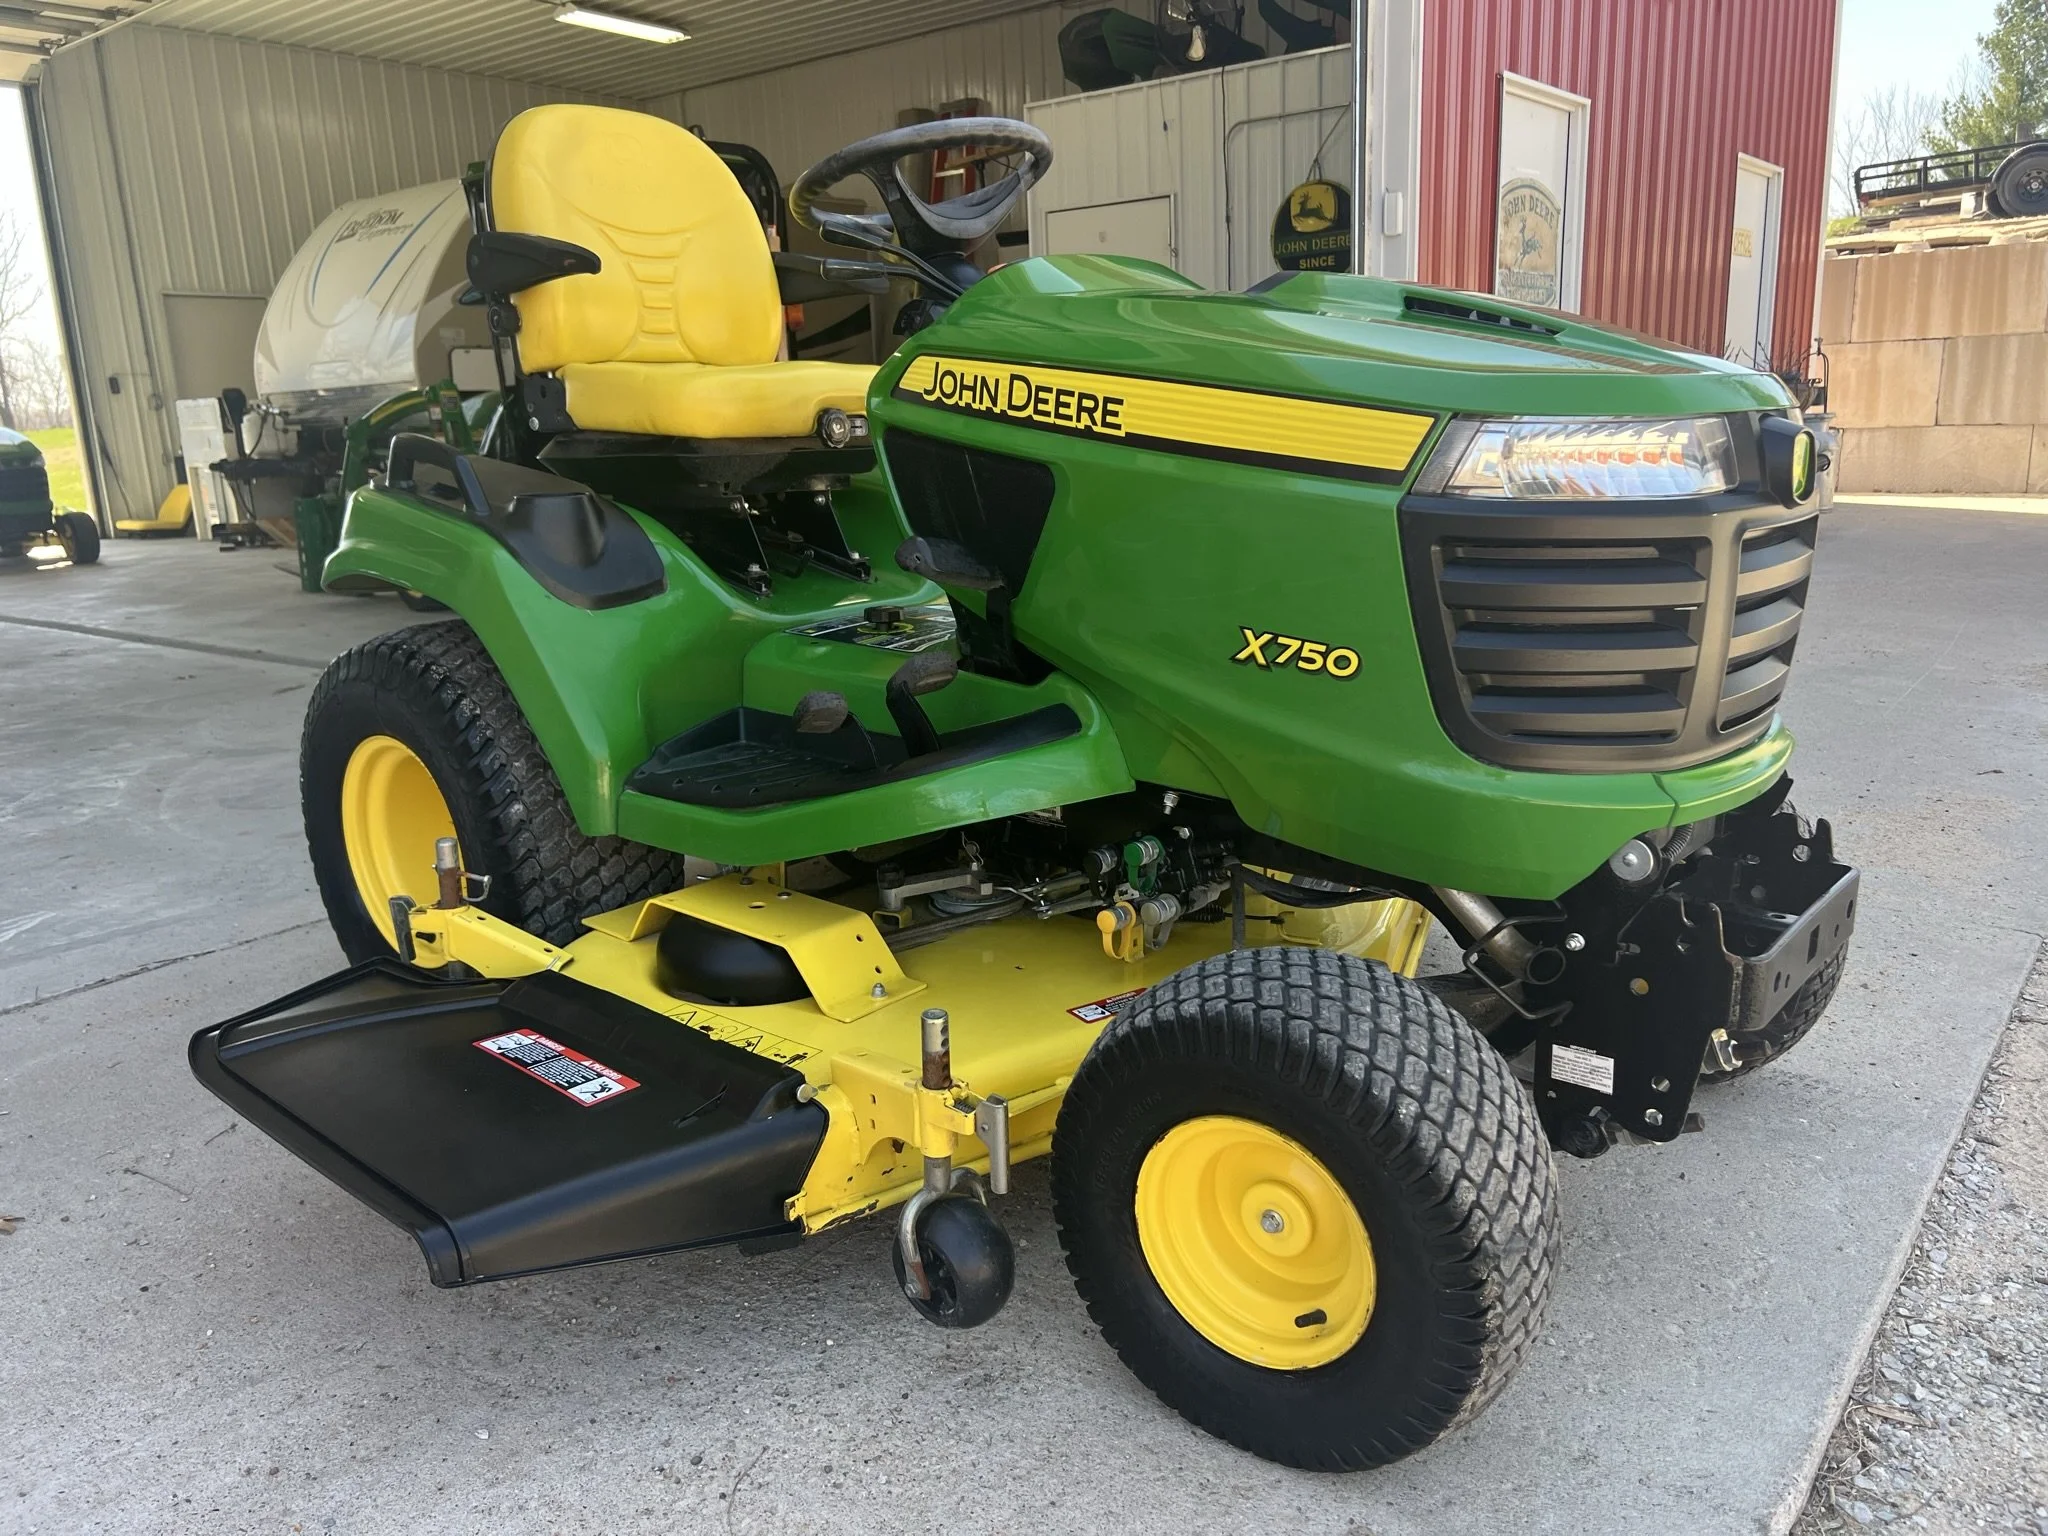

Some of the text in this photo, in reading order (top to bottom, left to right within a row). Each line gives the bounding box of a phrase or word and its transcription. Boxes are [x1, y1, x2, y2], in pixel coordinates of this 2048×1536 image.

[1503, 194, 1555, 230] JOHN DEERE
[1275, 235, 1351, 255] JOHN DEERE
[1299, 256, 1336, 269] SINCE
[923, 361, 1125, 432] JOHN DEERE
[1232, 627, 1361, 679] X750
